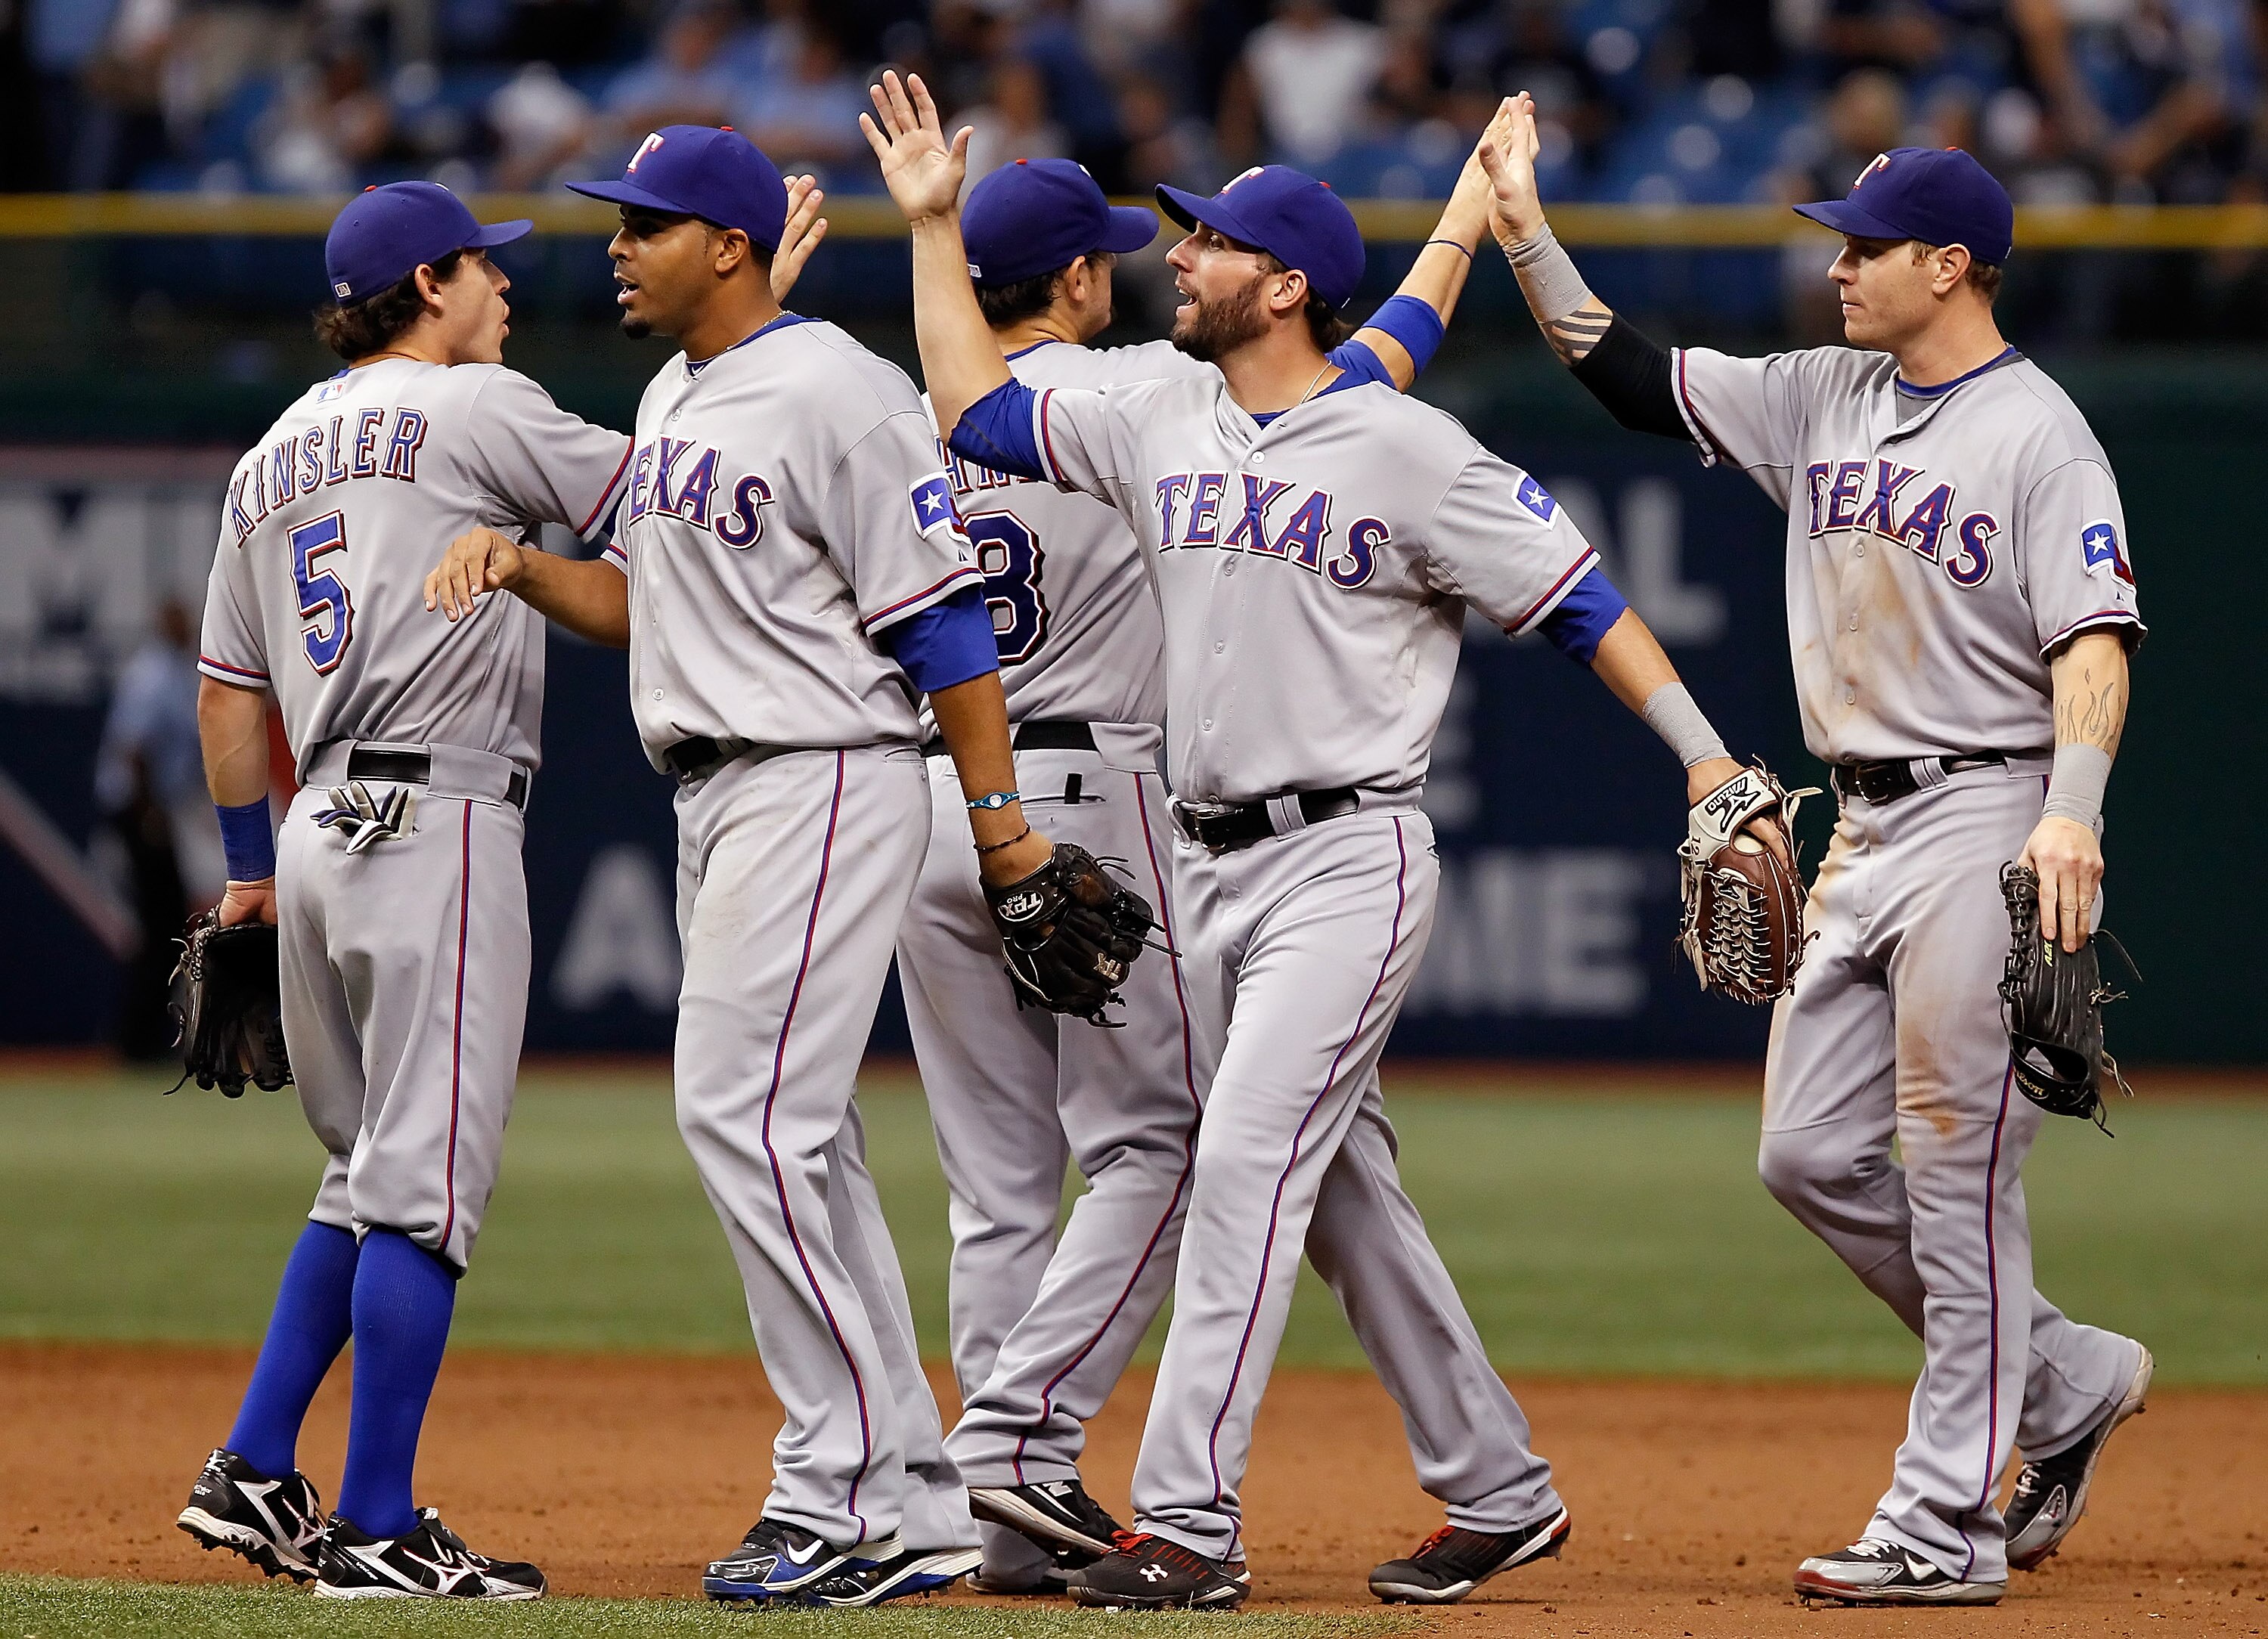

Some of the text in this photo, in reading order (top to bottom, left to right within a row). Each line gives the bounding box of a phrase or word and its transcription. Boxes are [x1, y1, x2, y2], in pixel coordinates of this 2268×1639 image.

[228, 407, 429, 544] KINSLER
[628, 433, 776, 551] EXAS
[1155, 469, 1392, 590] TEXAS
[1807, 454, 2002, 590] TEXAS
[287, 508, 356, 678] 5
[999, 892, 1041, 916] TPX
[1006, 893, 1023, 904] PRO
